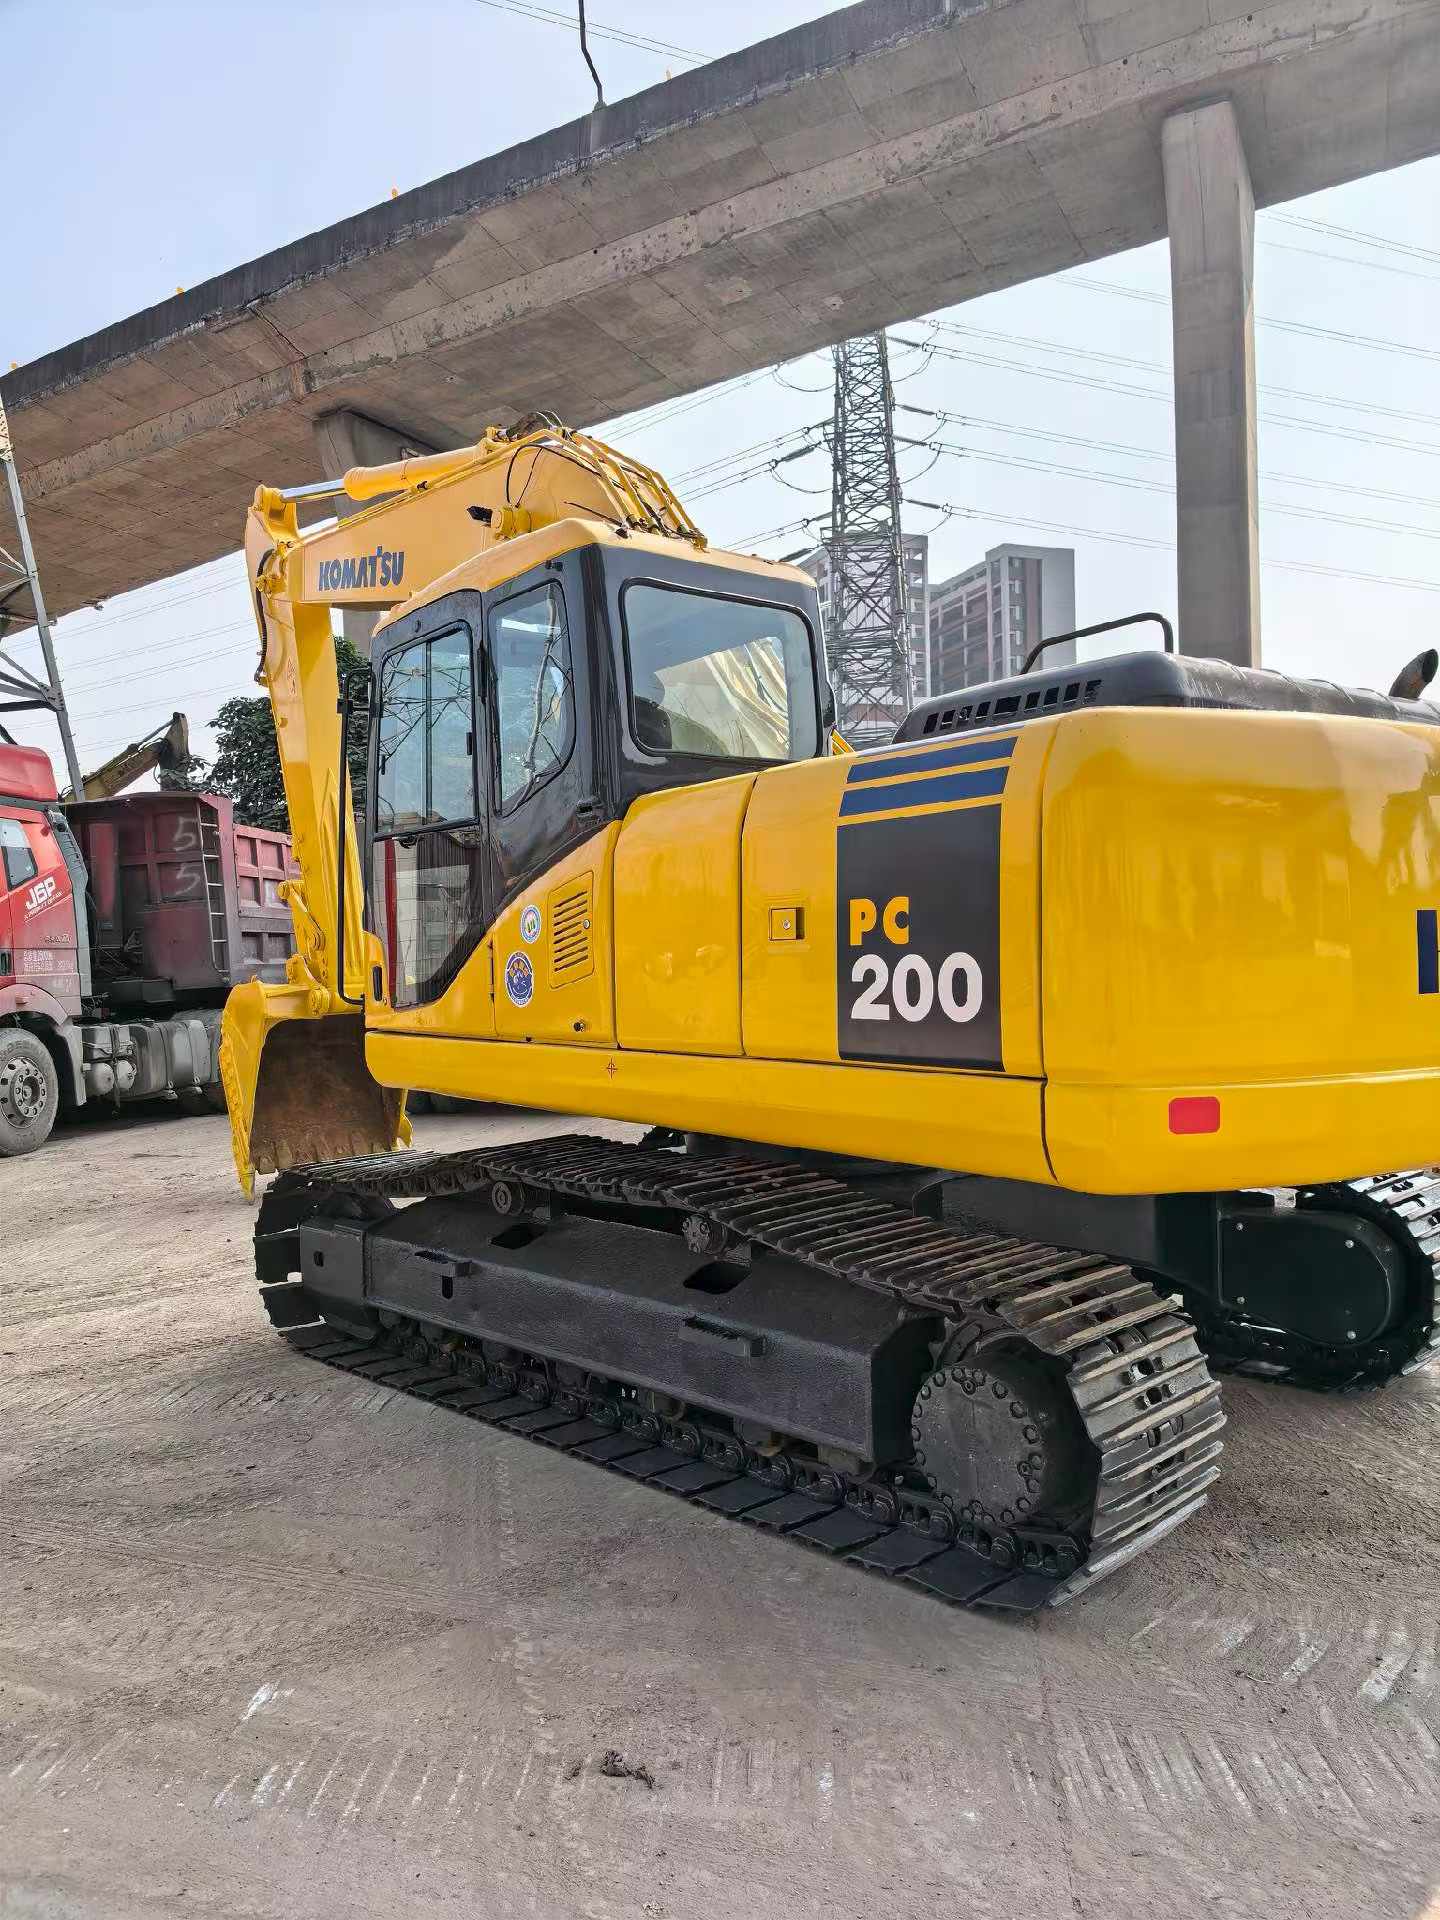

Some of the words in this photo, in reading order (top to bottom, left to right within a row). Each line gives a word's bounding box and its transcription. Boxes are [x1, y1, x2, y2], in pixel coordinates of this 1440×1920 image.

[318, 546, 405, 591] KOMATSU
[173, 816, 199, 852] 5
[25, 876, 56, 910] J6P
[175, 862, 202, 895] 5
[850, 896, 910, 946] PC
[851, 951, 983, 1023] 200
